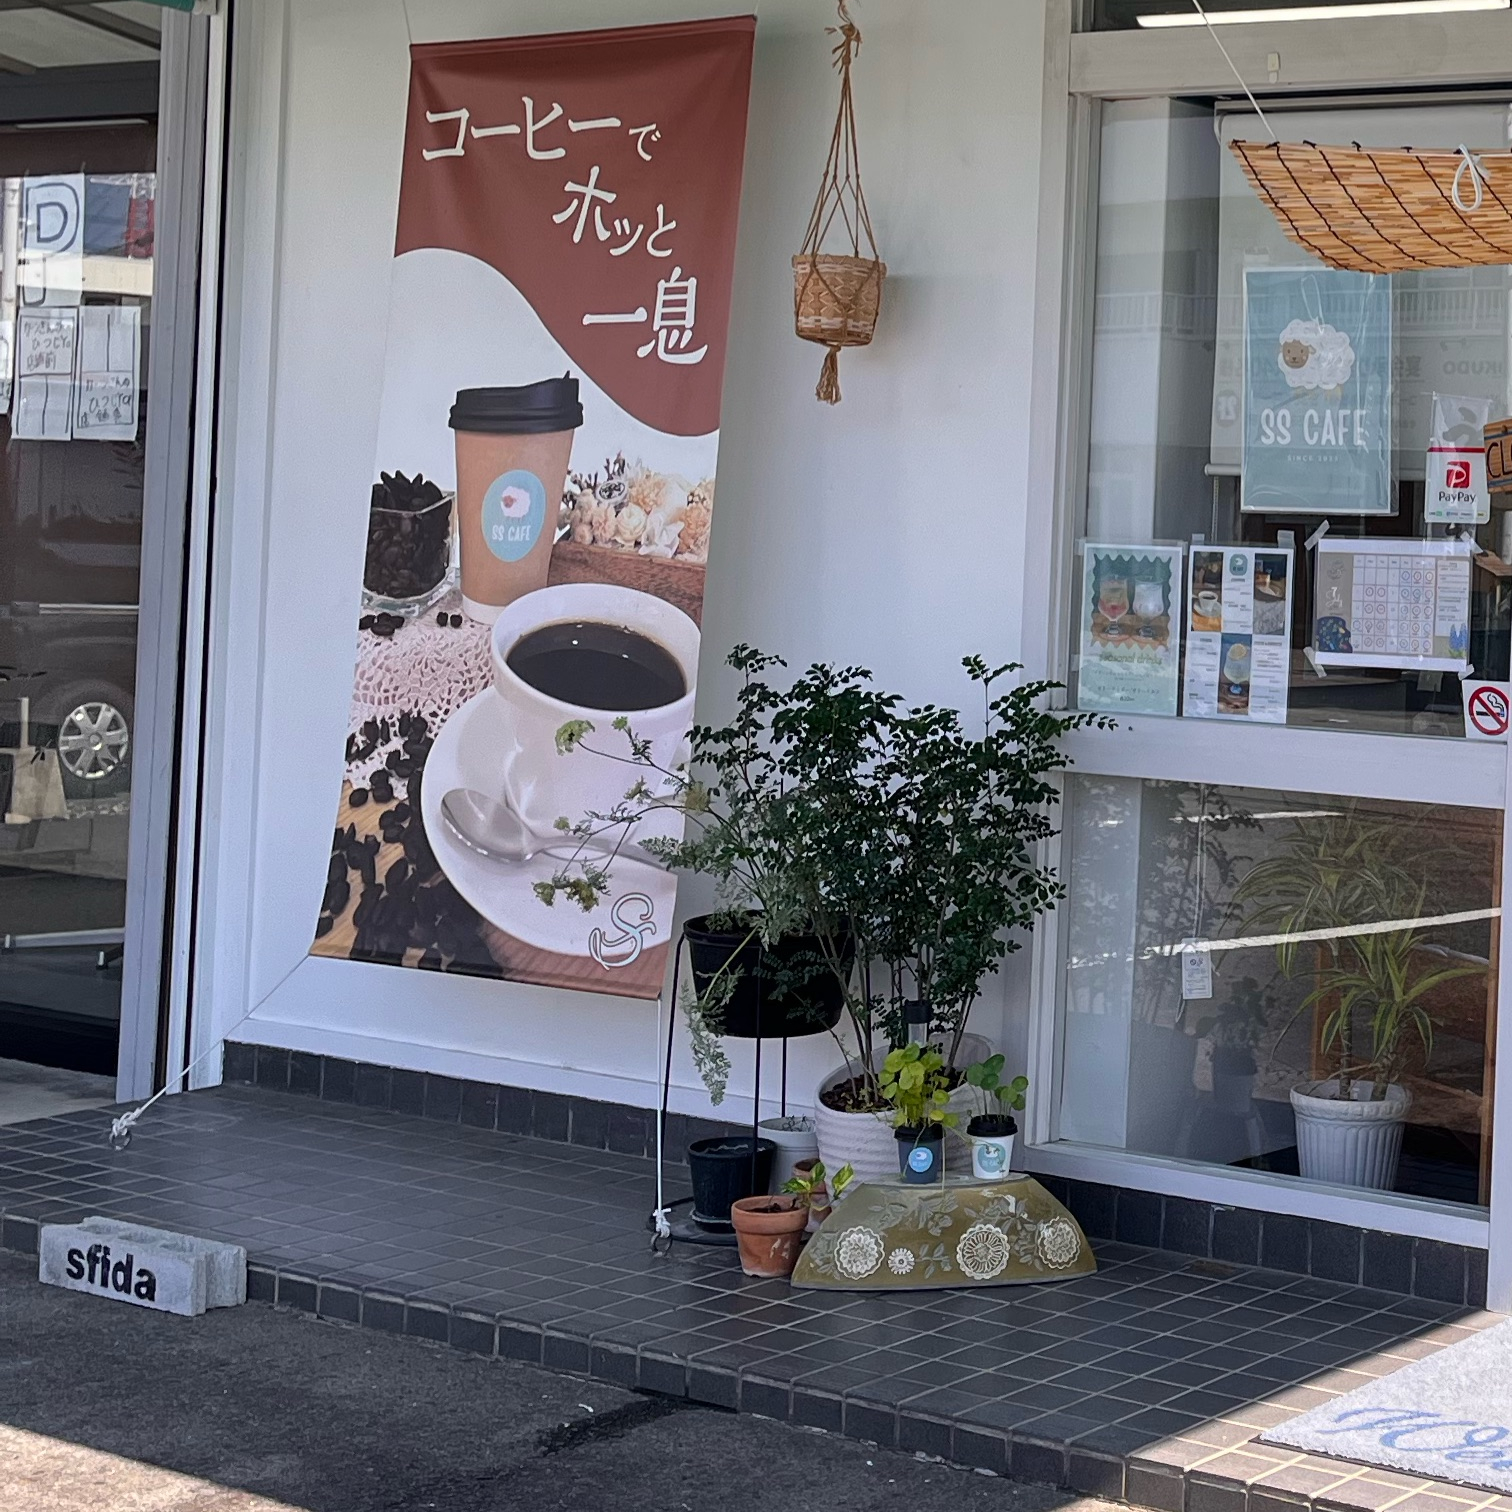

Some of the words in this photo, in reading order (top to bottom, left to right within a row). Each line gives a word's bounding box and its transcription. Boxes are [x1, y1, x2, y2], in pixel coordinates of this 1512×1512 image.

[421, 96, 661, 161] コーヒーで
[552, 165, 677, 257] ホッと
[582, 266, 708, 365] 一息
[1260, 408, 1292, 445] SS
[1302, 408, 1369, 447] CAFE
[1438, 491, 1477, 504] PayPay
[491, 524, 504, 541] SS
[507, 526, 531, 542] CAFE
[66, 1244, 157, 1302] sfida
